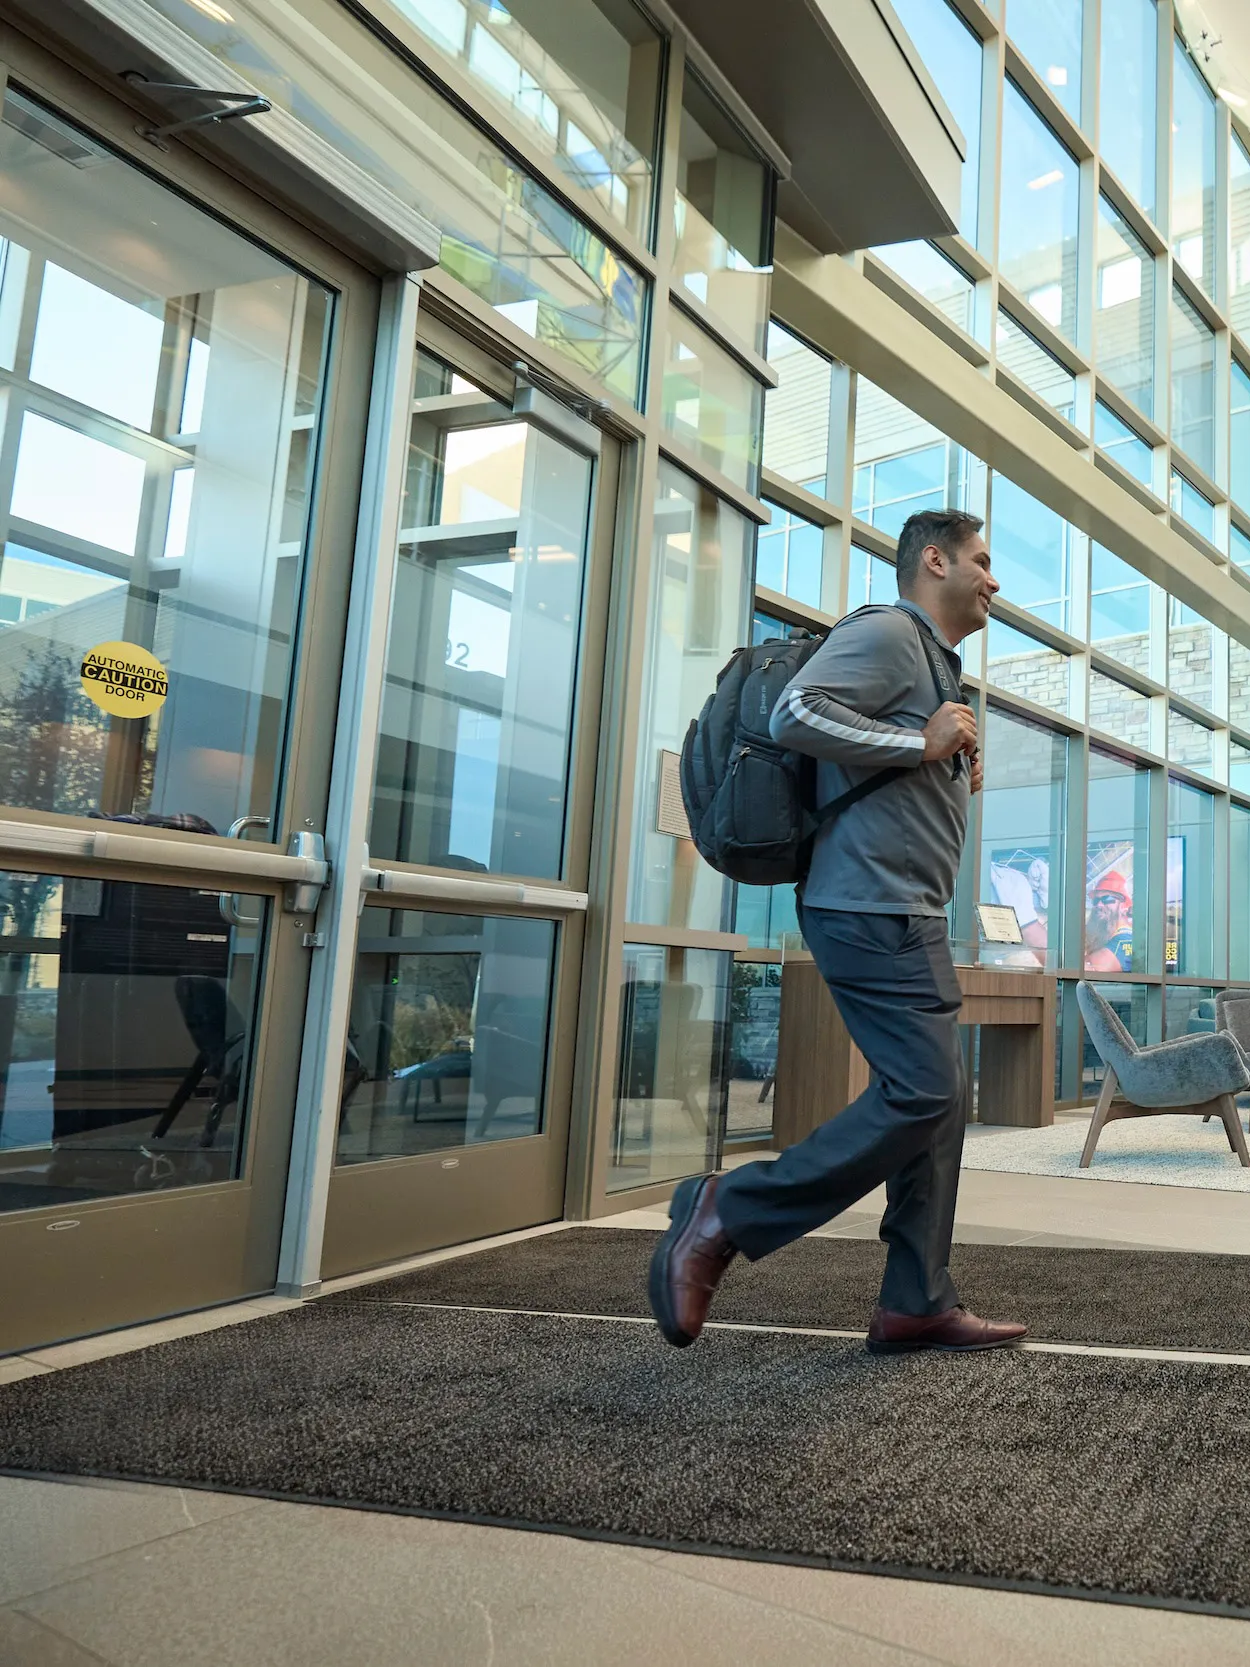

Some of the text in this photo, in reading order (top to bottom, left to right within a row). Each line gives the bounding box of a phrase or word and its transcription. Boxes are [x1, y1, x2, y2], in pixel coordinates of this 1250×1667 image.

[84, 665, 167, 695] CAUTION
[87, 654, 165, 680] AUTOMATIC
[105, 684, 145, 702] DOOR
